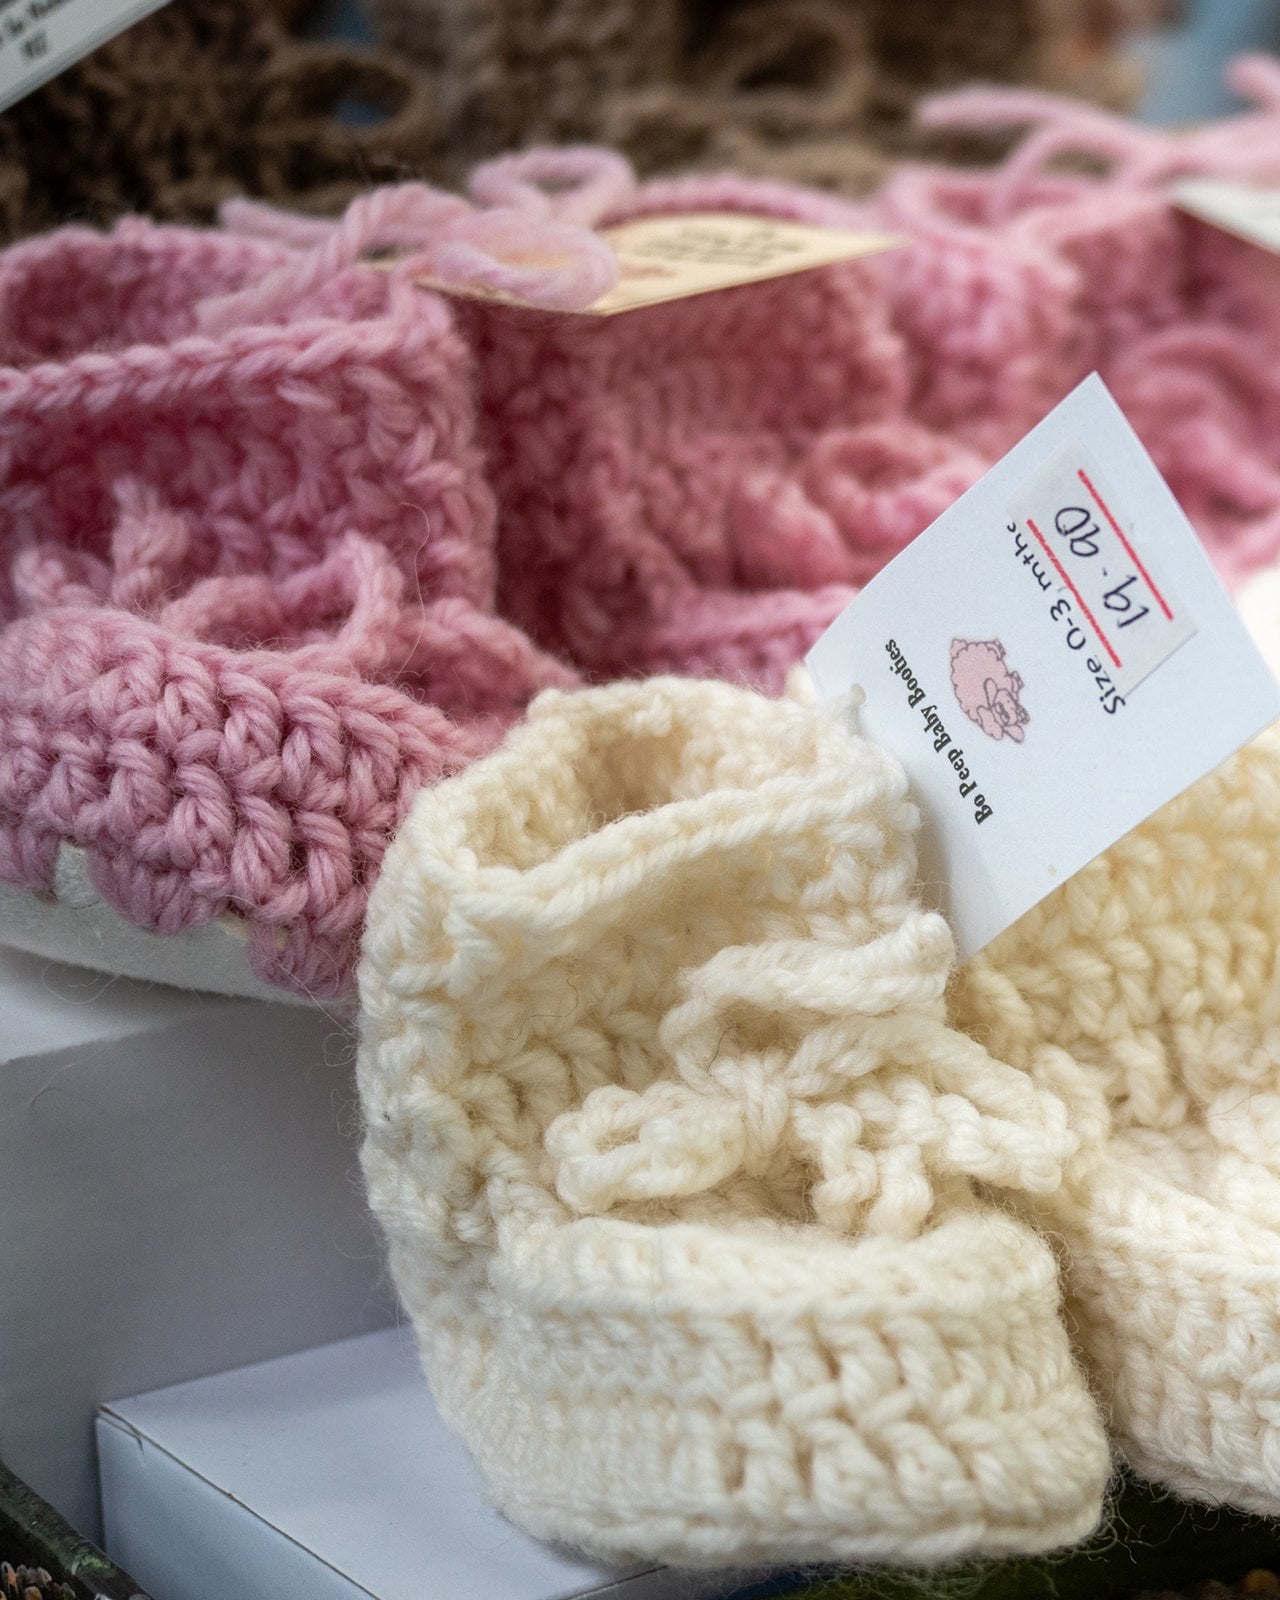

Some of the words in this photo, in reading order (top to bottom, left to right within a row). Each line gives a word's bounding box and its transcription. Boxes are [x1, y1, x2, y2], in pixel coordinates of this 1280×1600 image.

[1049, 598, 1087, 651] 0-3
[884, 638, 927, 710] Booties
[1086, 657, 1127, 715] Size
[920, 704, 953, 754] Baby
[947, 748, 979, 799] Peep
[973, 793, 994, 826] Bo
